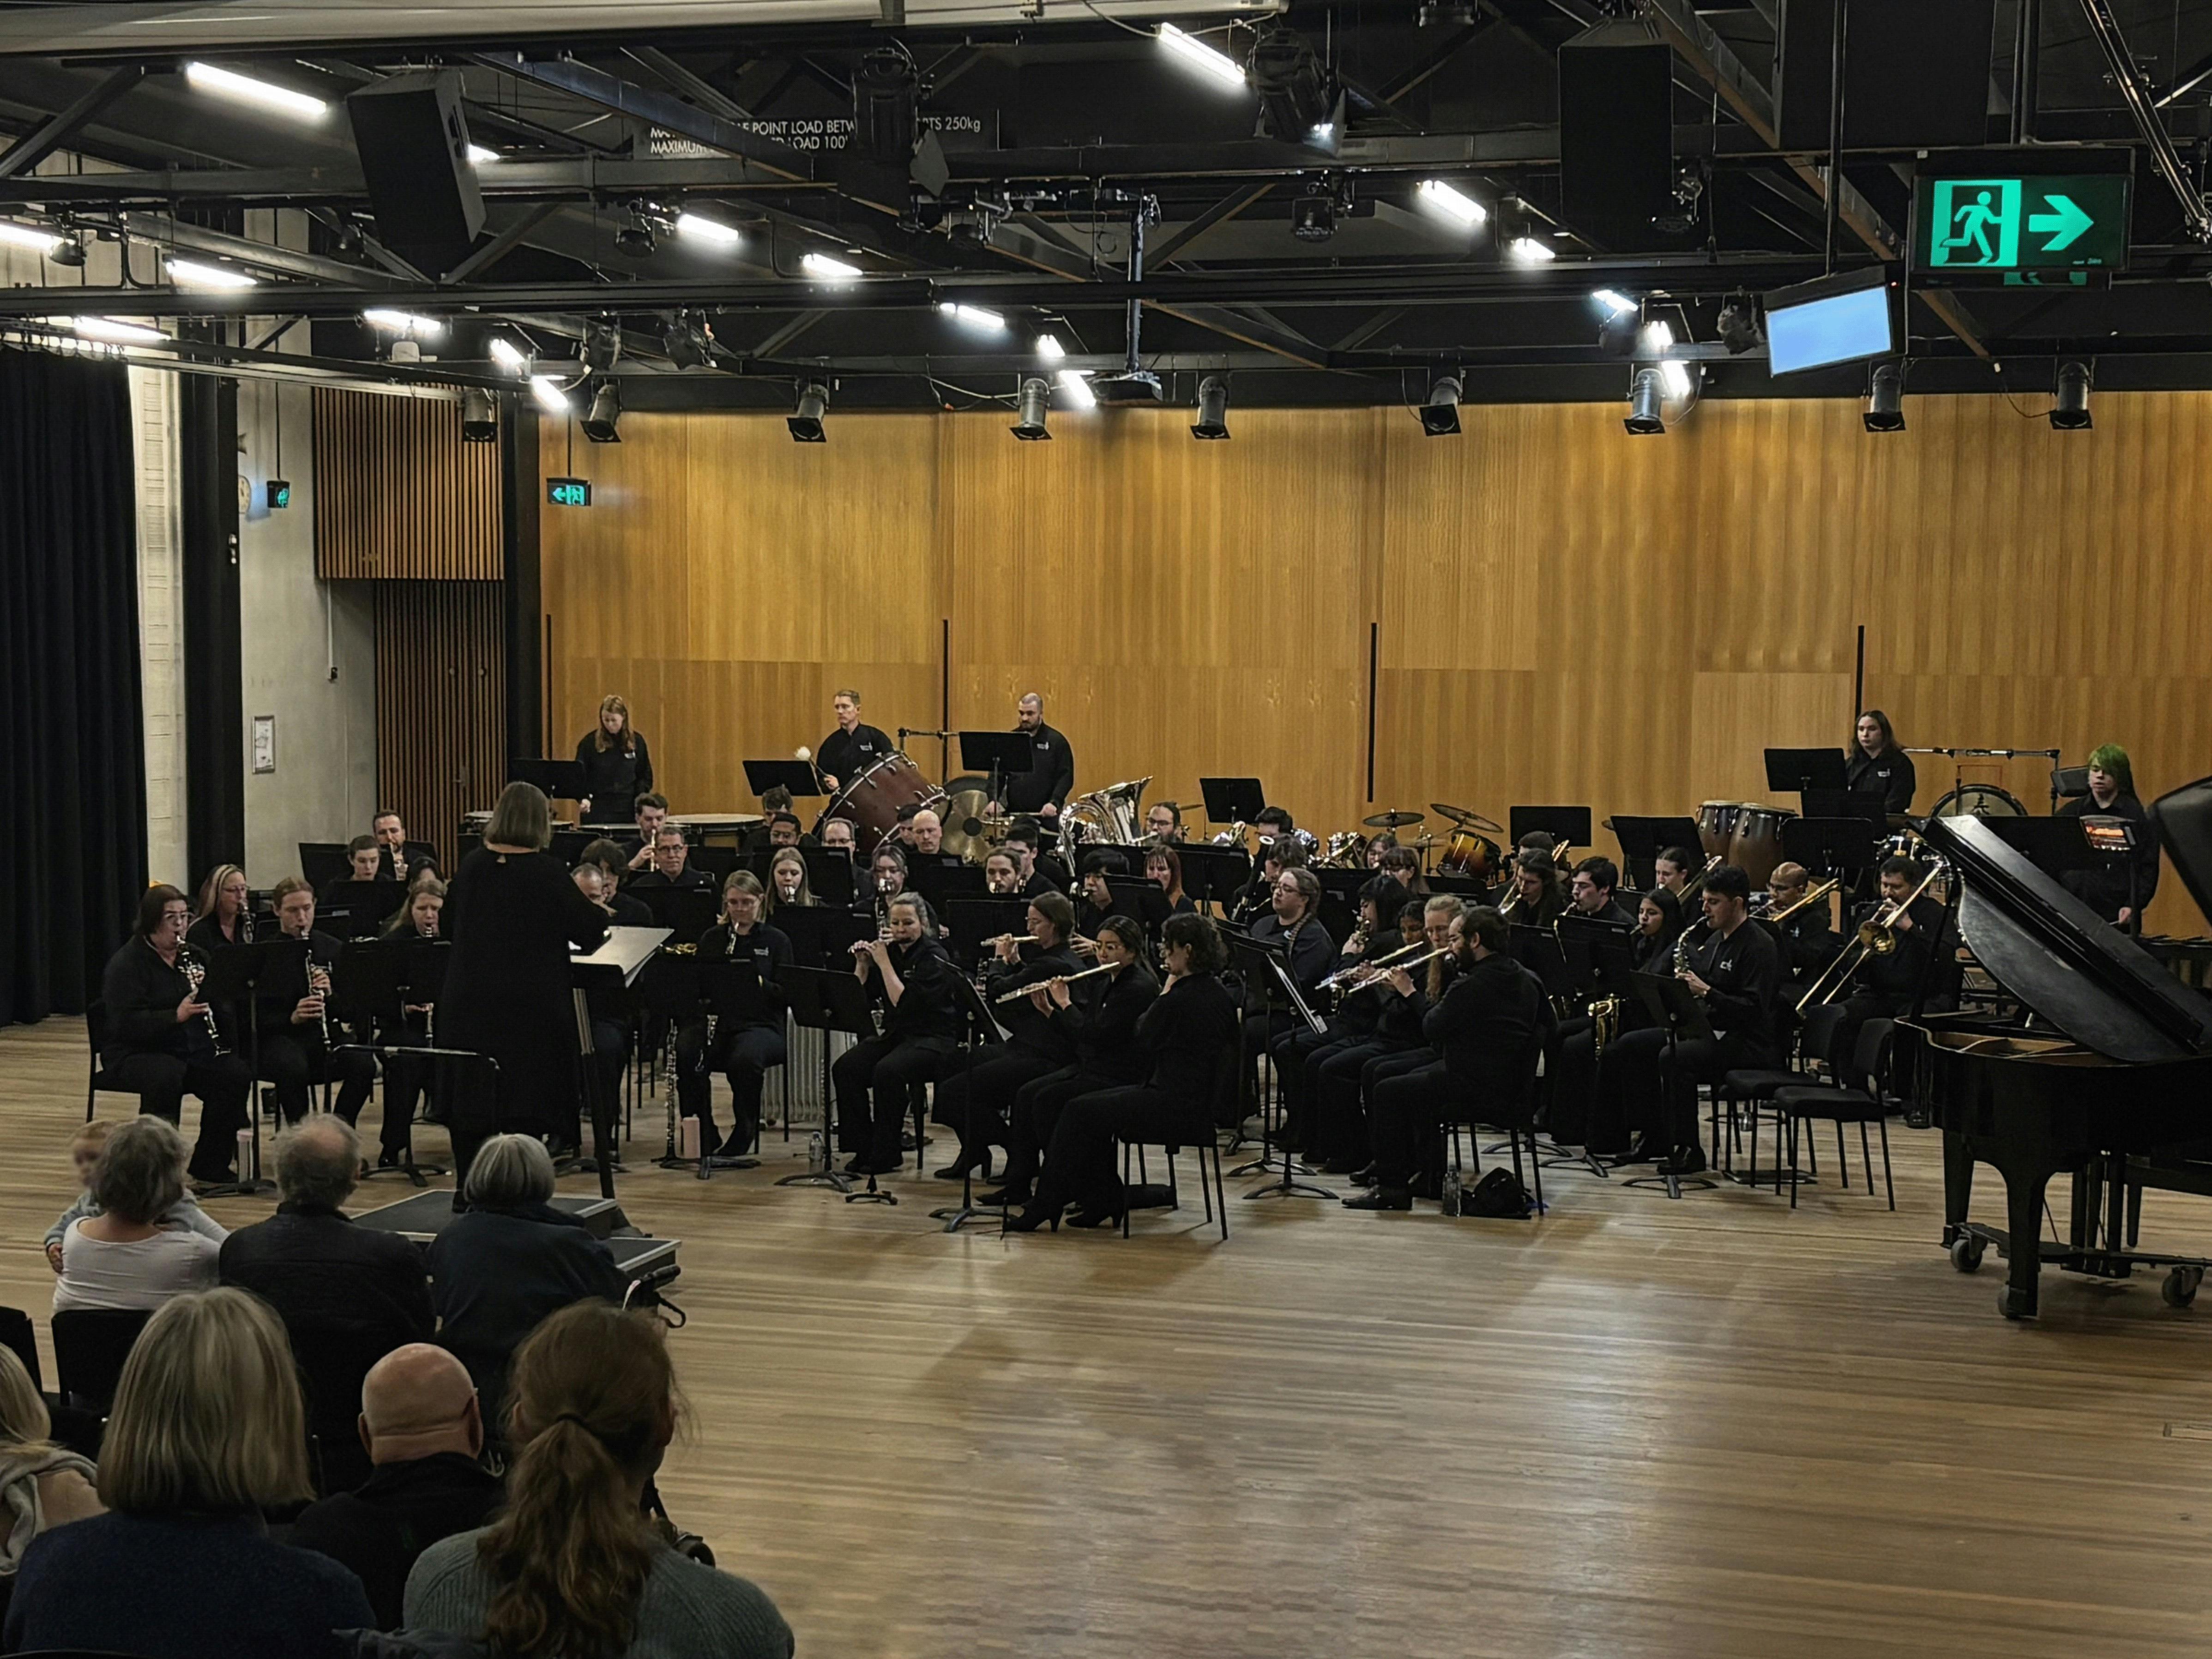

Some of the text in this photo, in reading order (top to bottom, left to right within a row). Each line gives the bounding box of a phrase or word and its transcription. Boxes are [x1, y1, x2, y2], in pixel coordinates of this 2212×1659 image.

[753, 121, 788, 135] POINT
[791, 121, 823, 134] LOAD
[946, 116, 981, 133] 250kg
[825, 135, 848, 149] 100
